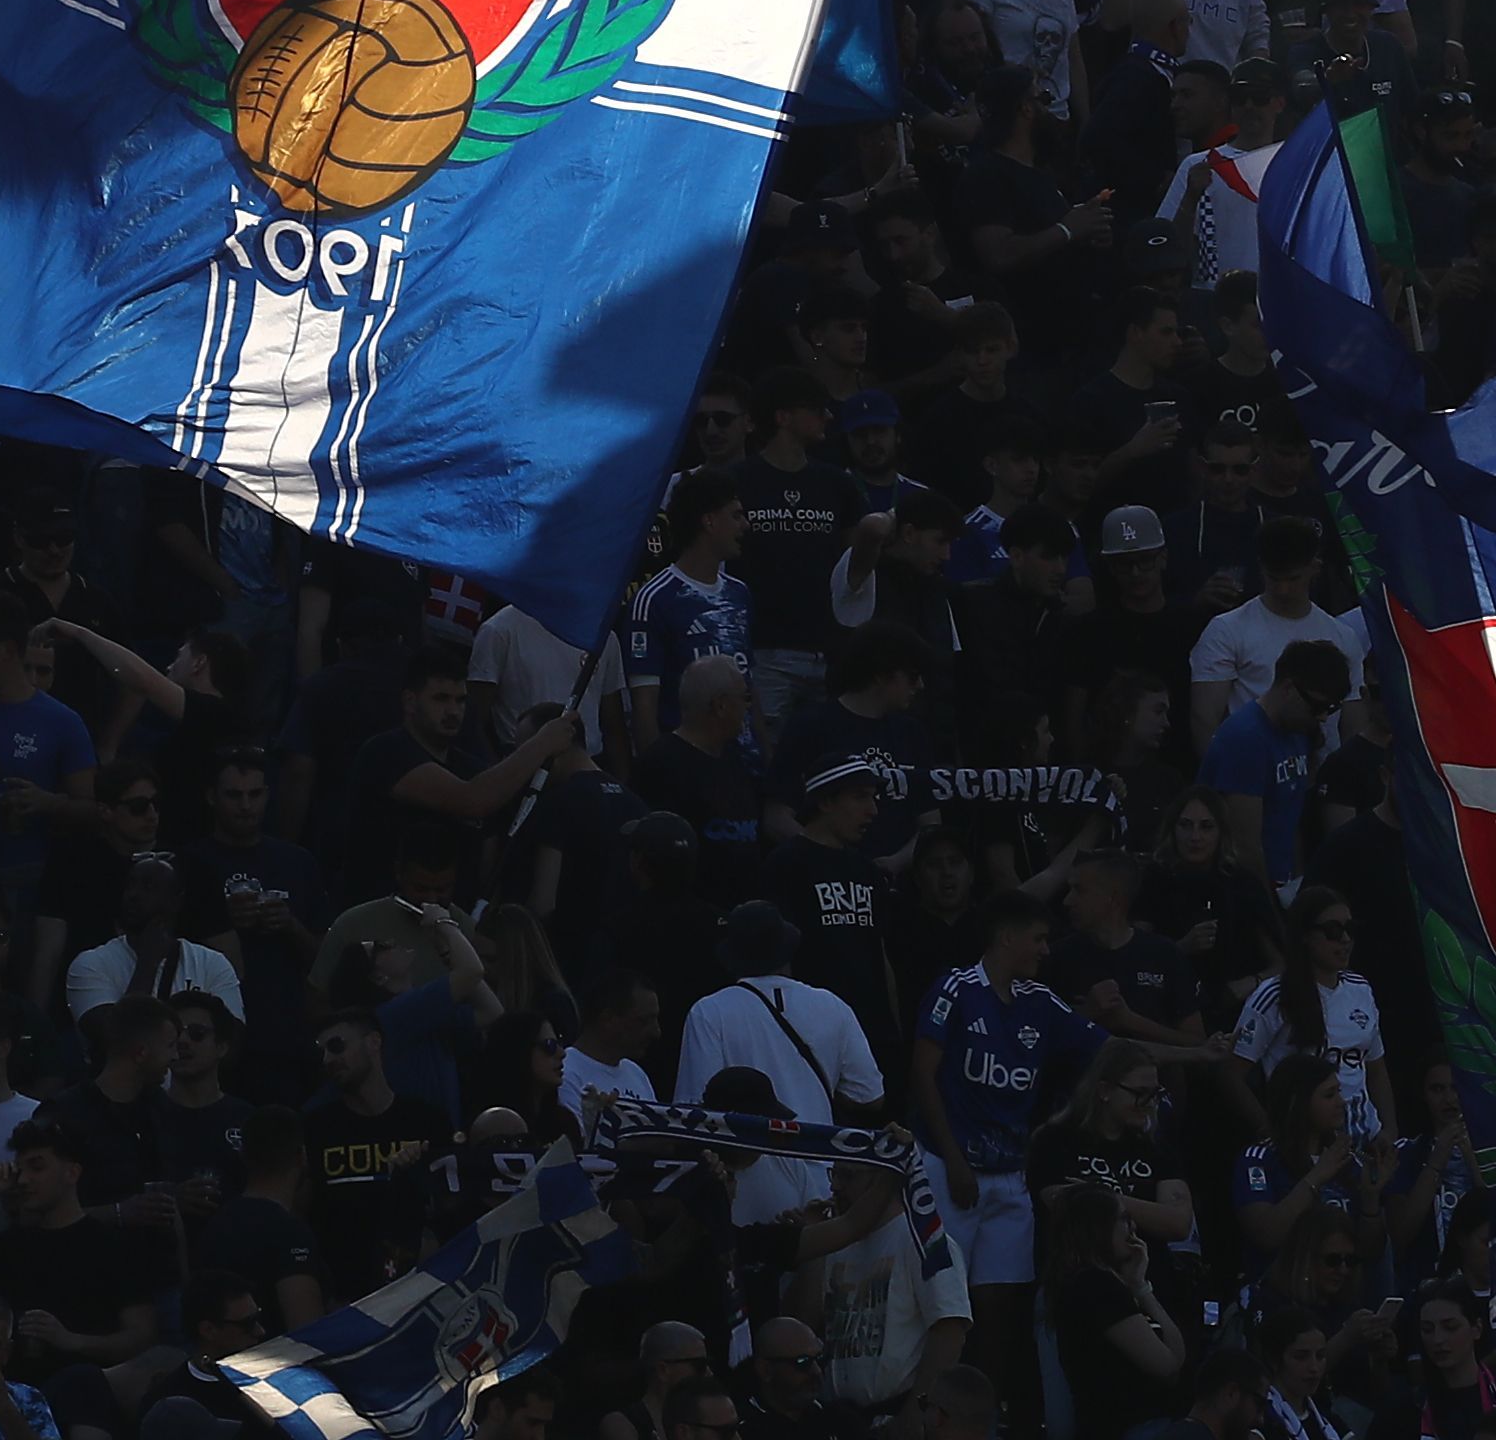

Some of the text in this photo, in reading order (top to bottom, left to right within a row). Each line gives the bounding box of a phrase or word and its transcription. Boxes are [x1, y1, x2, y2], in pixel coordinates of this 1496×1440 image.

[747, 508, 835, 522] PRIMA COMO
[751, 521, 835, 535] POI IL COMO
[1120, 521, 1137, 541] LA
[821, 913, 857, 927] COMO
[963, 1047, 1038, 1091] Uber
